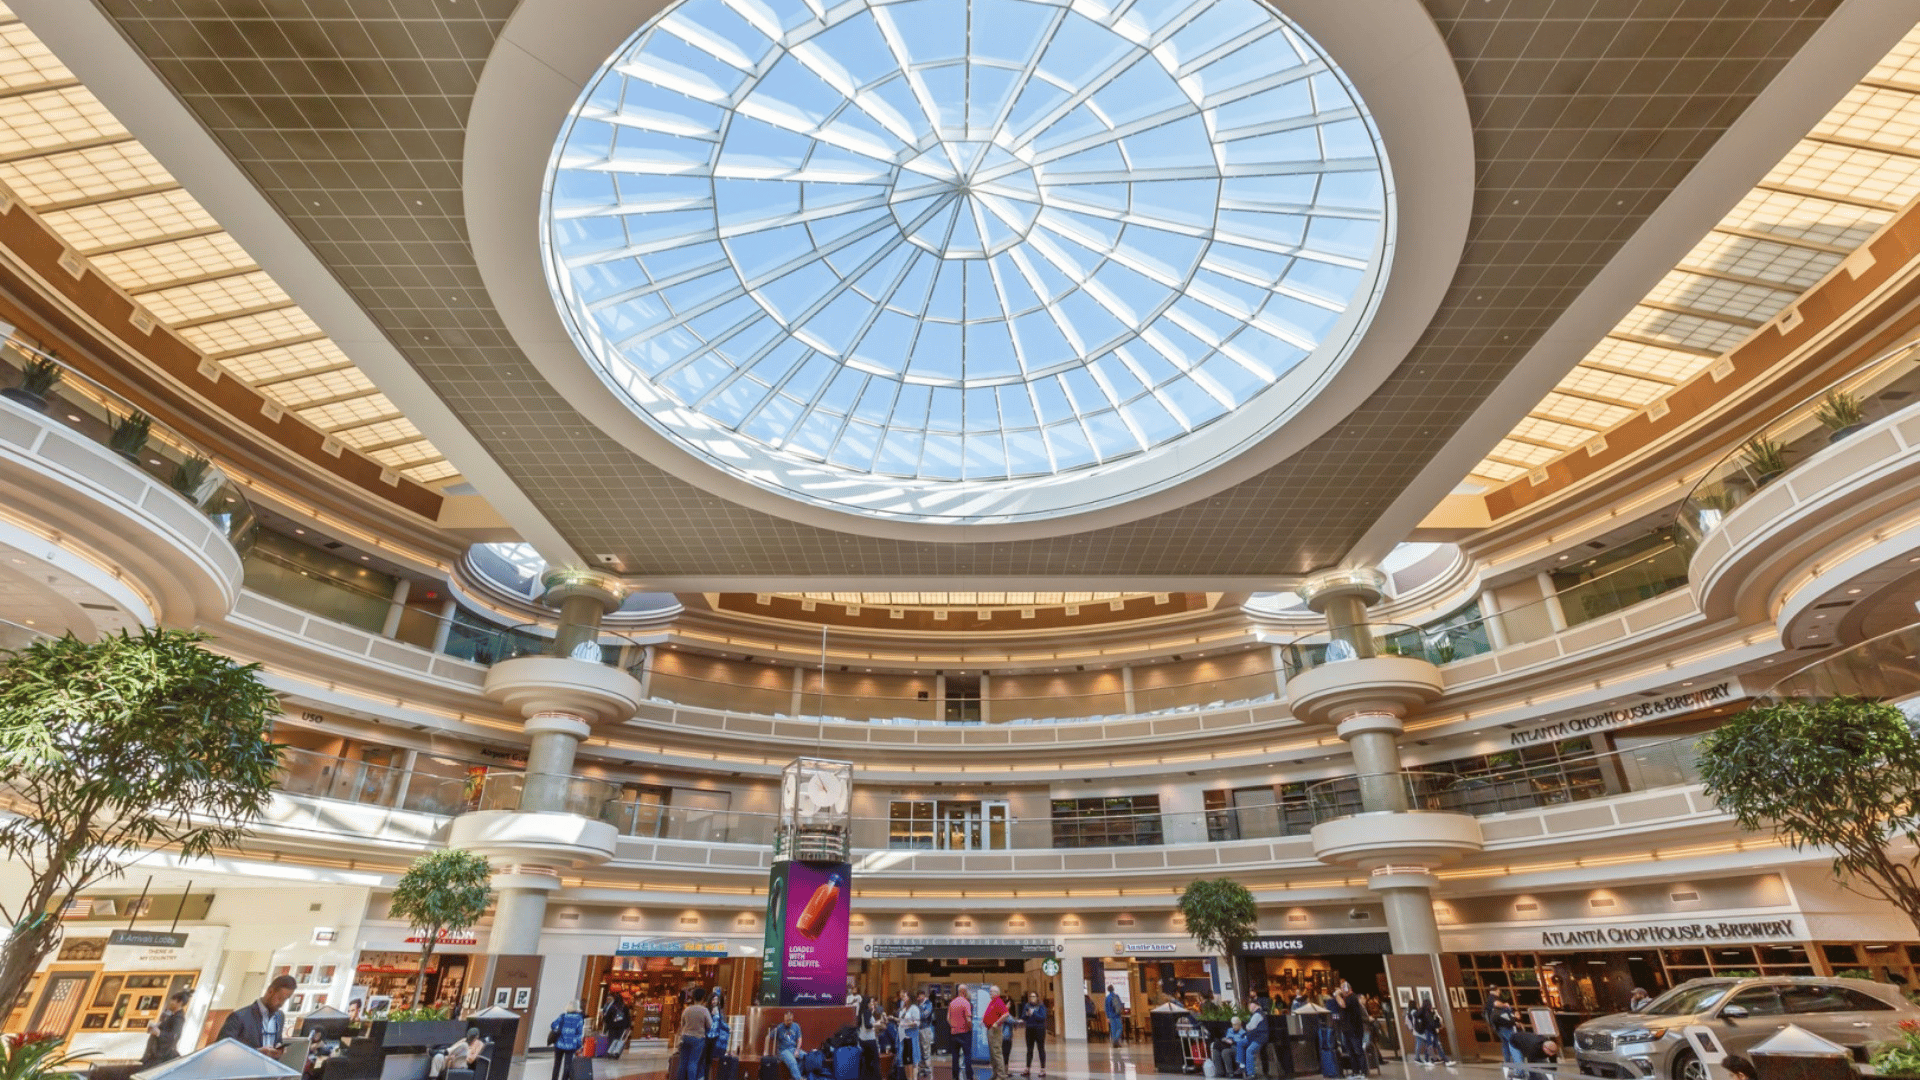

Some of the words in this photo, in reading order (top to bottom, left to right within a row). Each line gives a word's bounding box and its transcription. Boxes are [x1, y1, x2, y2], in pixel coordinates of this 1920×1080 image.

[301, 711, 323, 724] USO
[1511, 722, 1568, 745] ATLANTA
[1654, 700, 1665, 713] &
[1664, 683, 1730, 709] BREWERY
[125, 933, 153, 943] Arrivals
[154, 934, 177, 945] Lobby
[1542, 929, 1607, 946] ATLANTA
[1705, 924, 1717, 938] &
[1716, 919, 1795, 938] BREWERY
[1242, 940, 1303, 950] STARBUCKS
